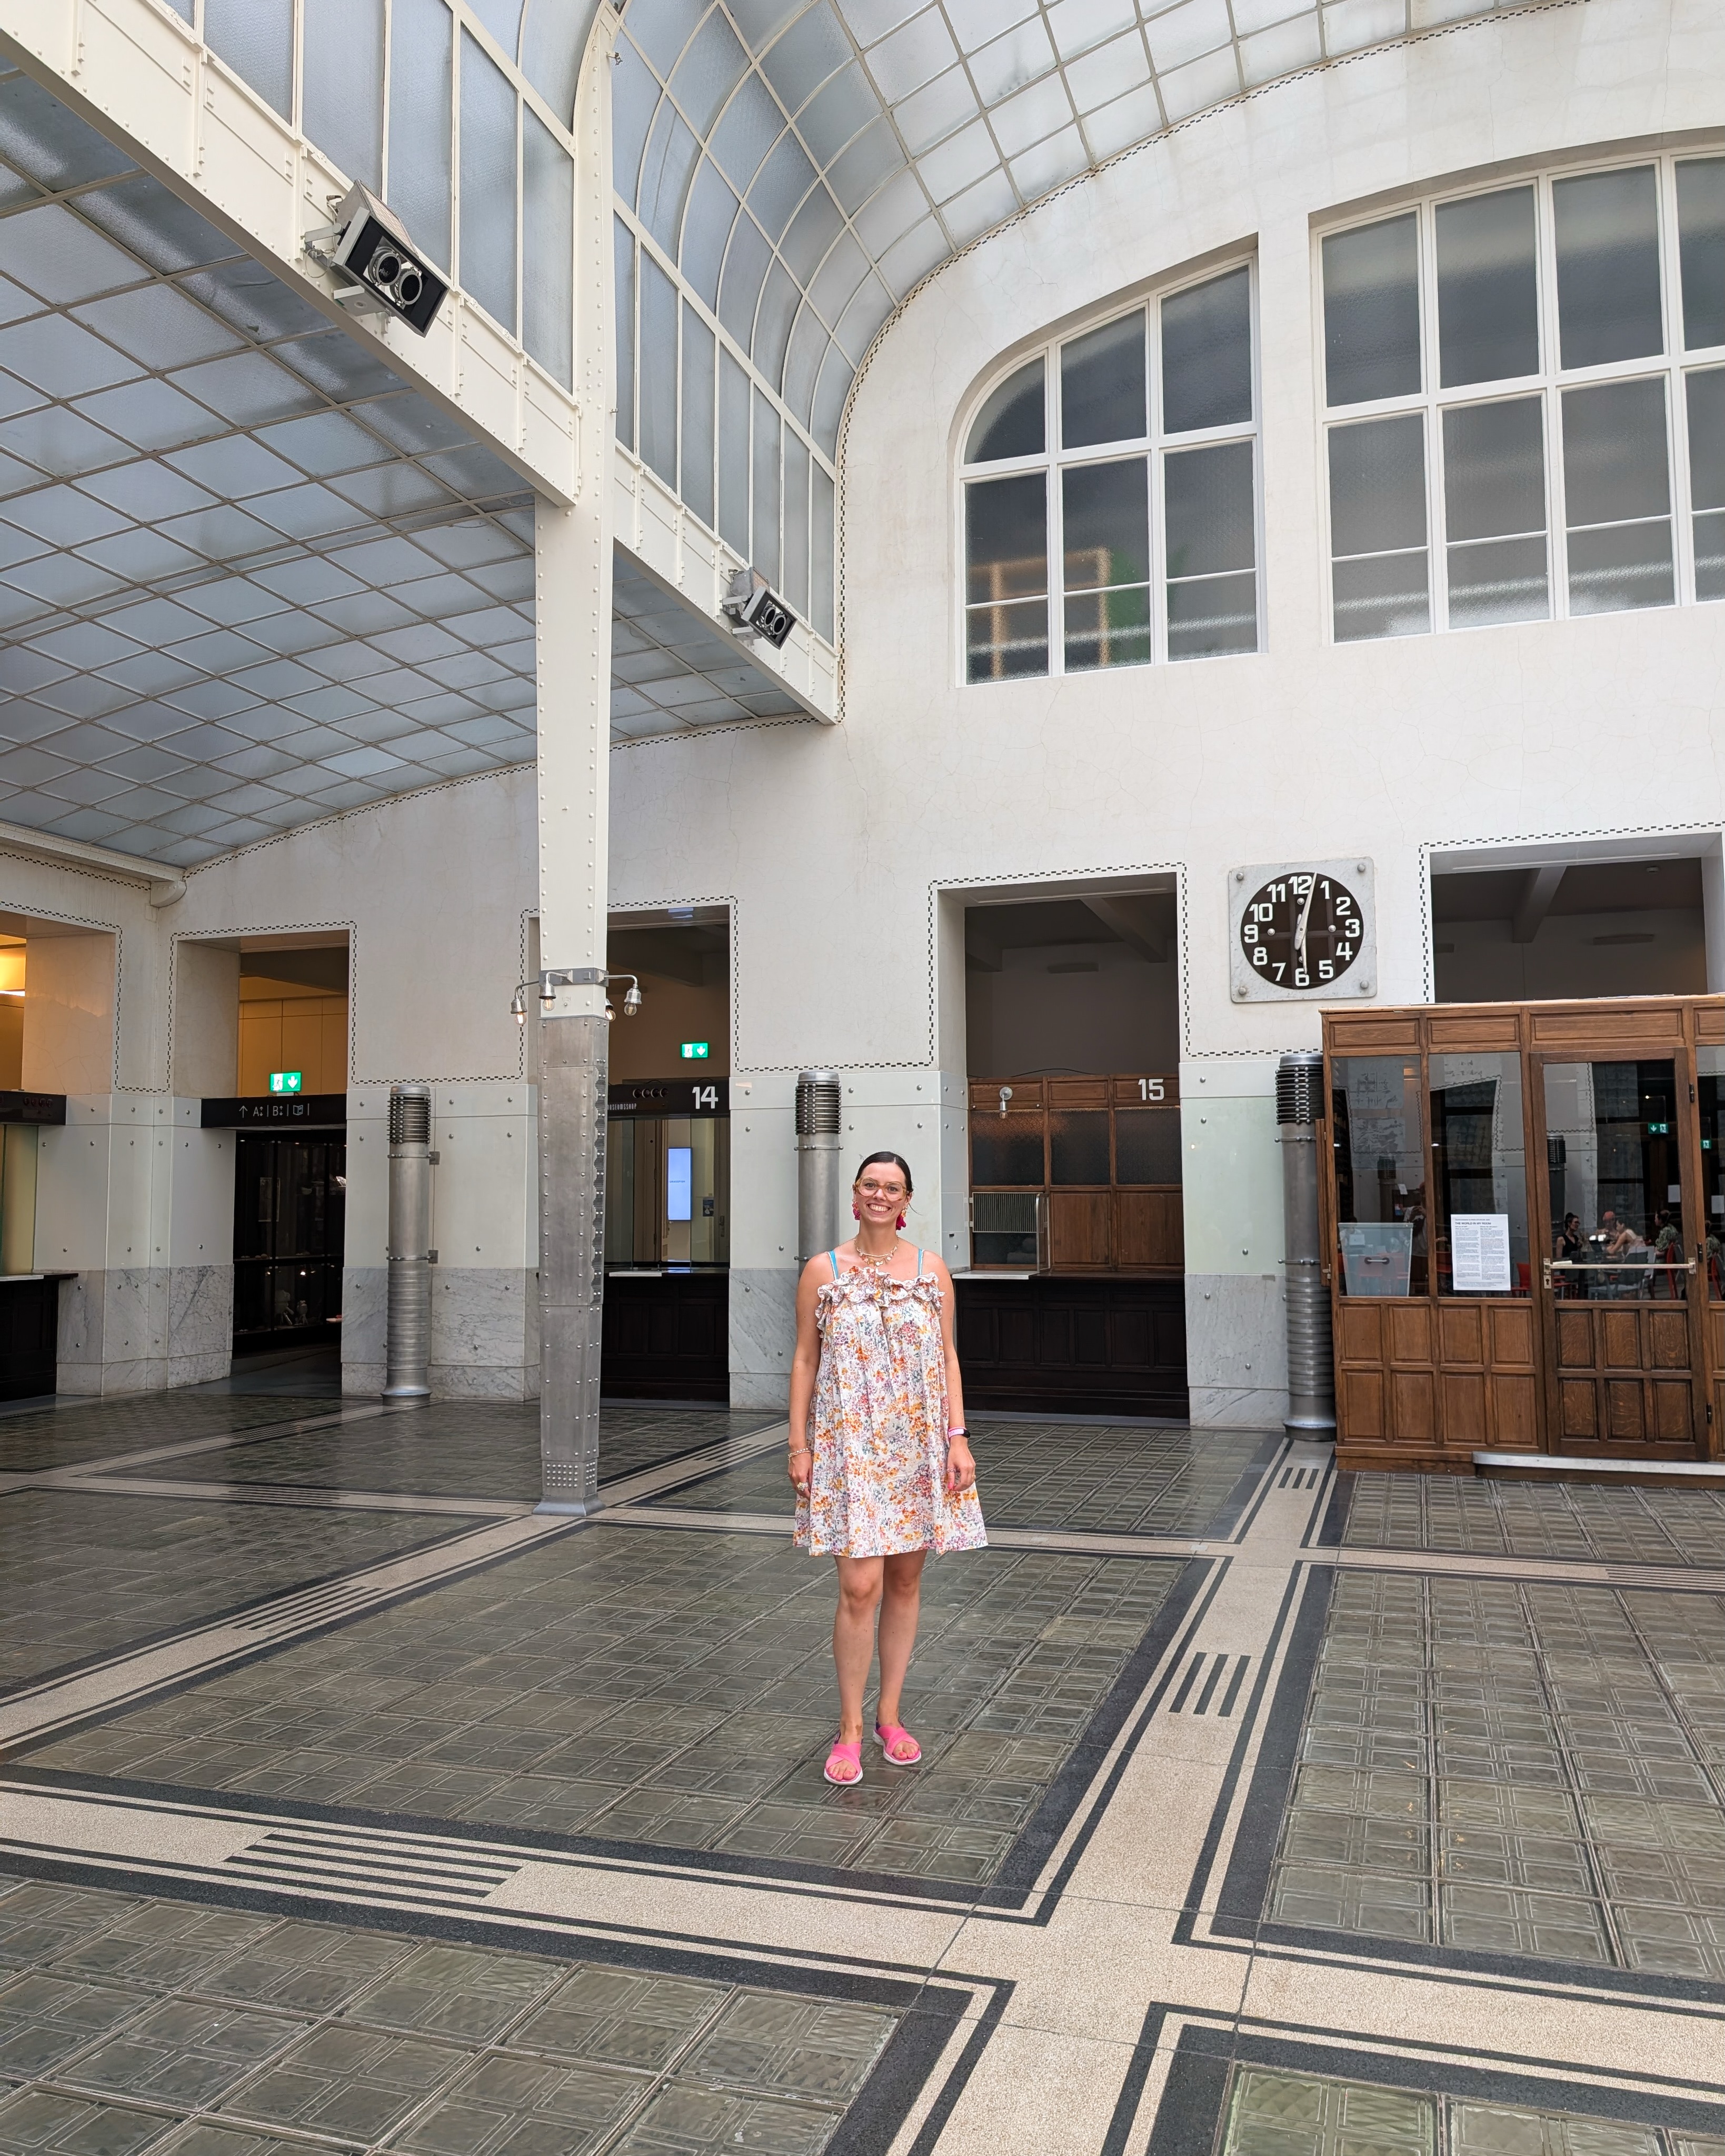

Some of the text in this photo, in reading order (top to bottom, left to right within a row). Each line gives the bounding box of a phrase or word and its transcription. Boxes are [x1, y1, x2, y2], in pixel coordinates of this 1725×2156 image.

[1267, 883, 1286, 903] 11
[1288, 875, 1312, 895] 12
[1320, 881, 1330, 900] 1
[1249, 903, 1273, 922] 10
[1336, 896, 1351, 916] 2
[1244, 924, 1259, 943] 9
[1345, 919, 1360, 937] 3
[1253, 947, 1268, 966] 8
[1335, 942, 1353, 961] 4
[1272, 962, 1287, 982] 7
[1295, 967, 1310, 986] 6
[1319, 960, 1334, 979] 5
[692, 1086, 719, 1110] 14
[1138, 1079, 1164, 1101] 15
[253, 1105, 278, 1117] A B
